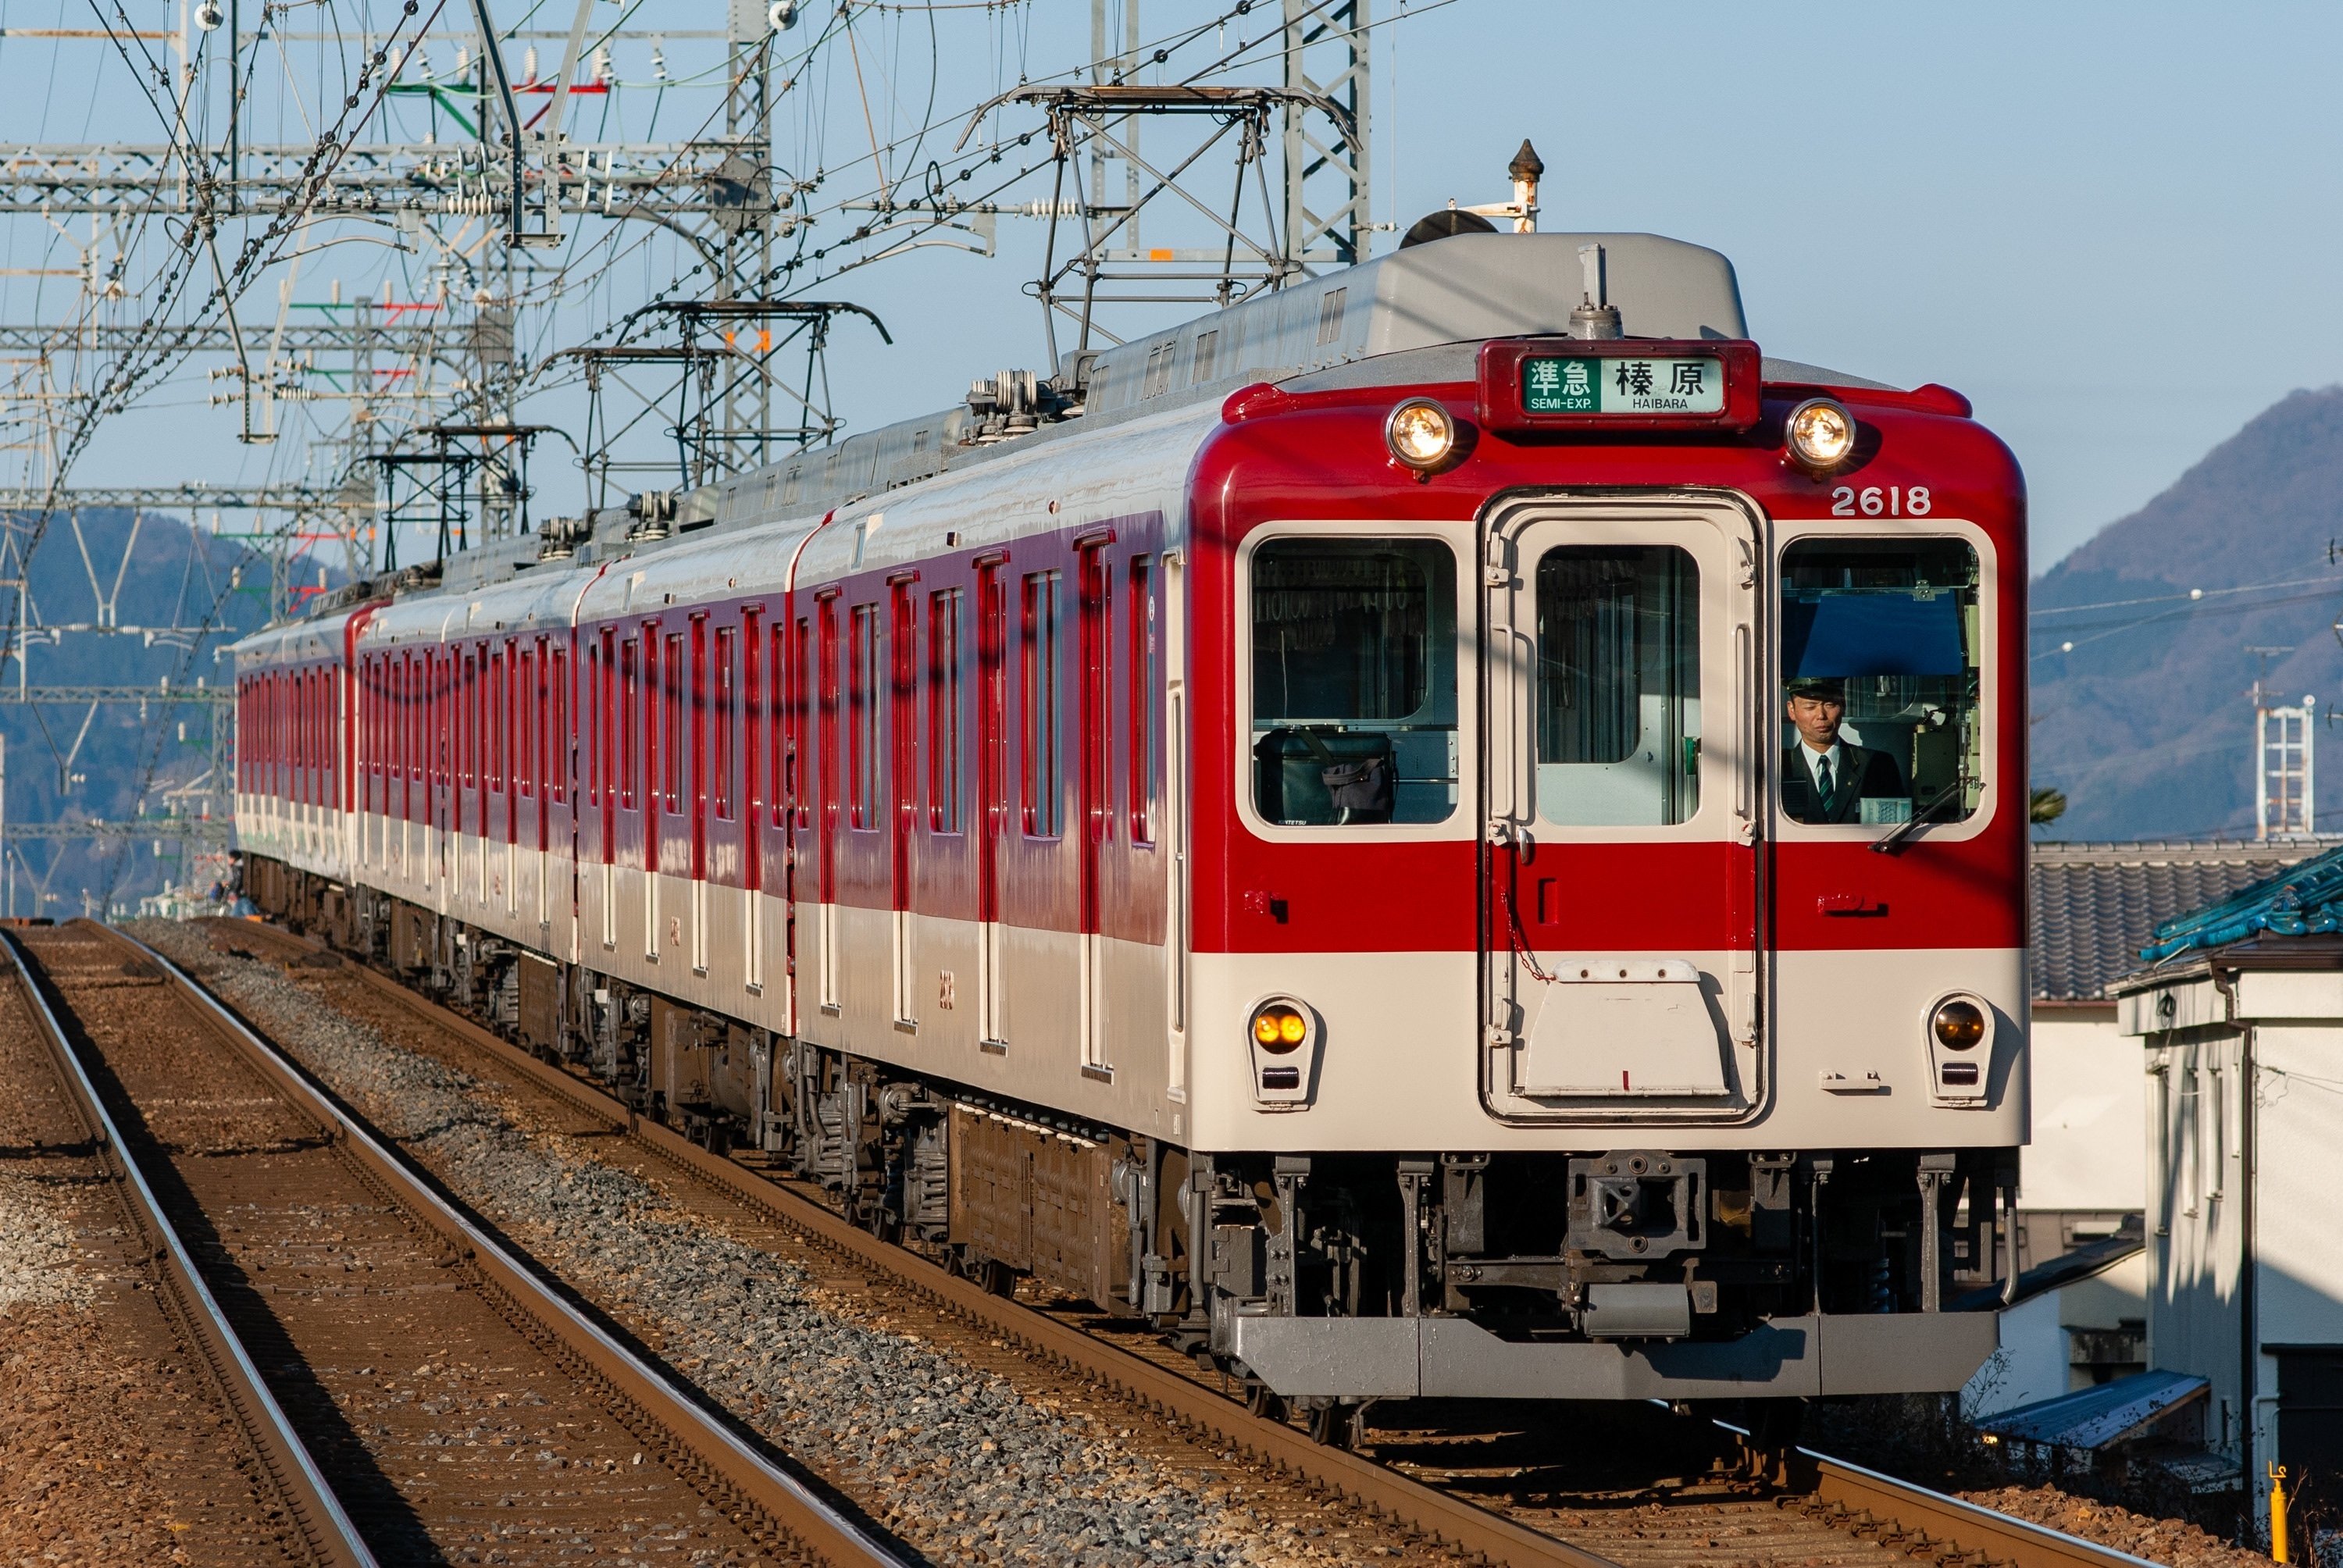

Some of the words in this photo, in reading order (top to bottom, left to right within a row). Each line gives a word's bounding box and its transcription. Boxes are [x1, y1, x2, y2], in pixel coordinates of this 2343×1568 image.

[1532, 361, 1590, 396] 準急
[1616, 362, 1704, 396] 榛原
[1532, 398, 1592, 409] SEMI-EXP.
[1633, 398, 1688, 408] HAIBARA
[1831, 486, 1931, 515] 2618
